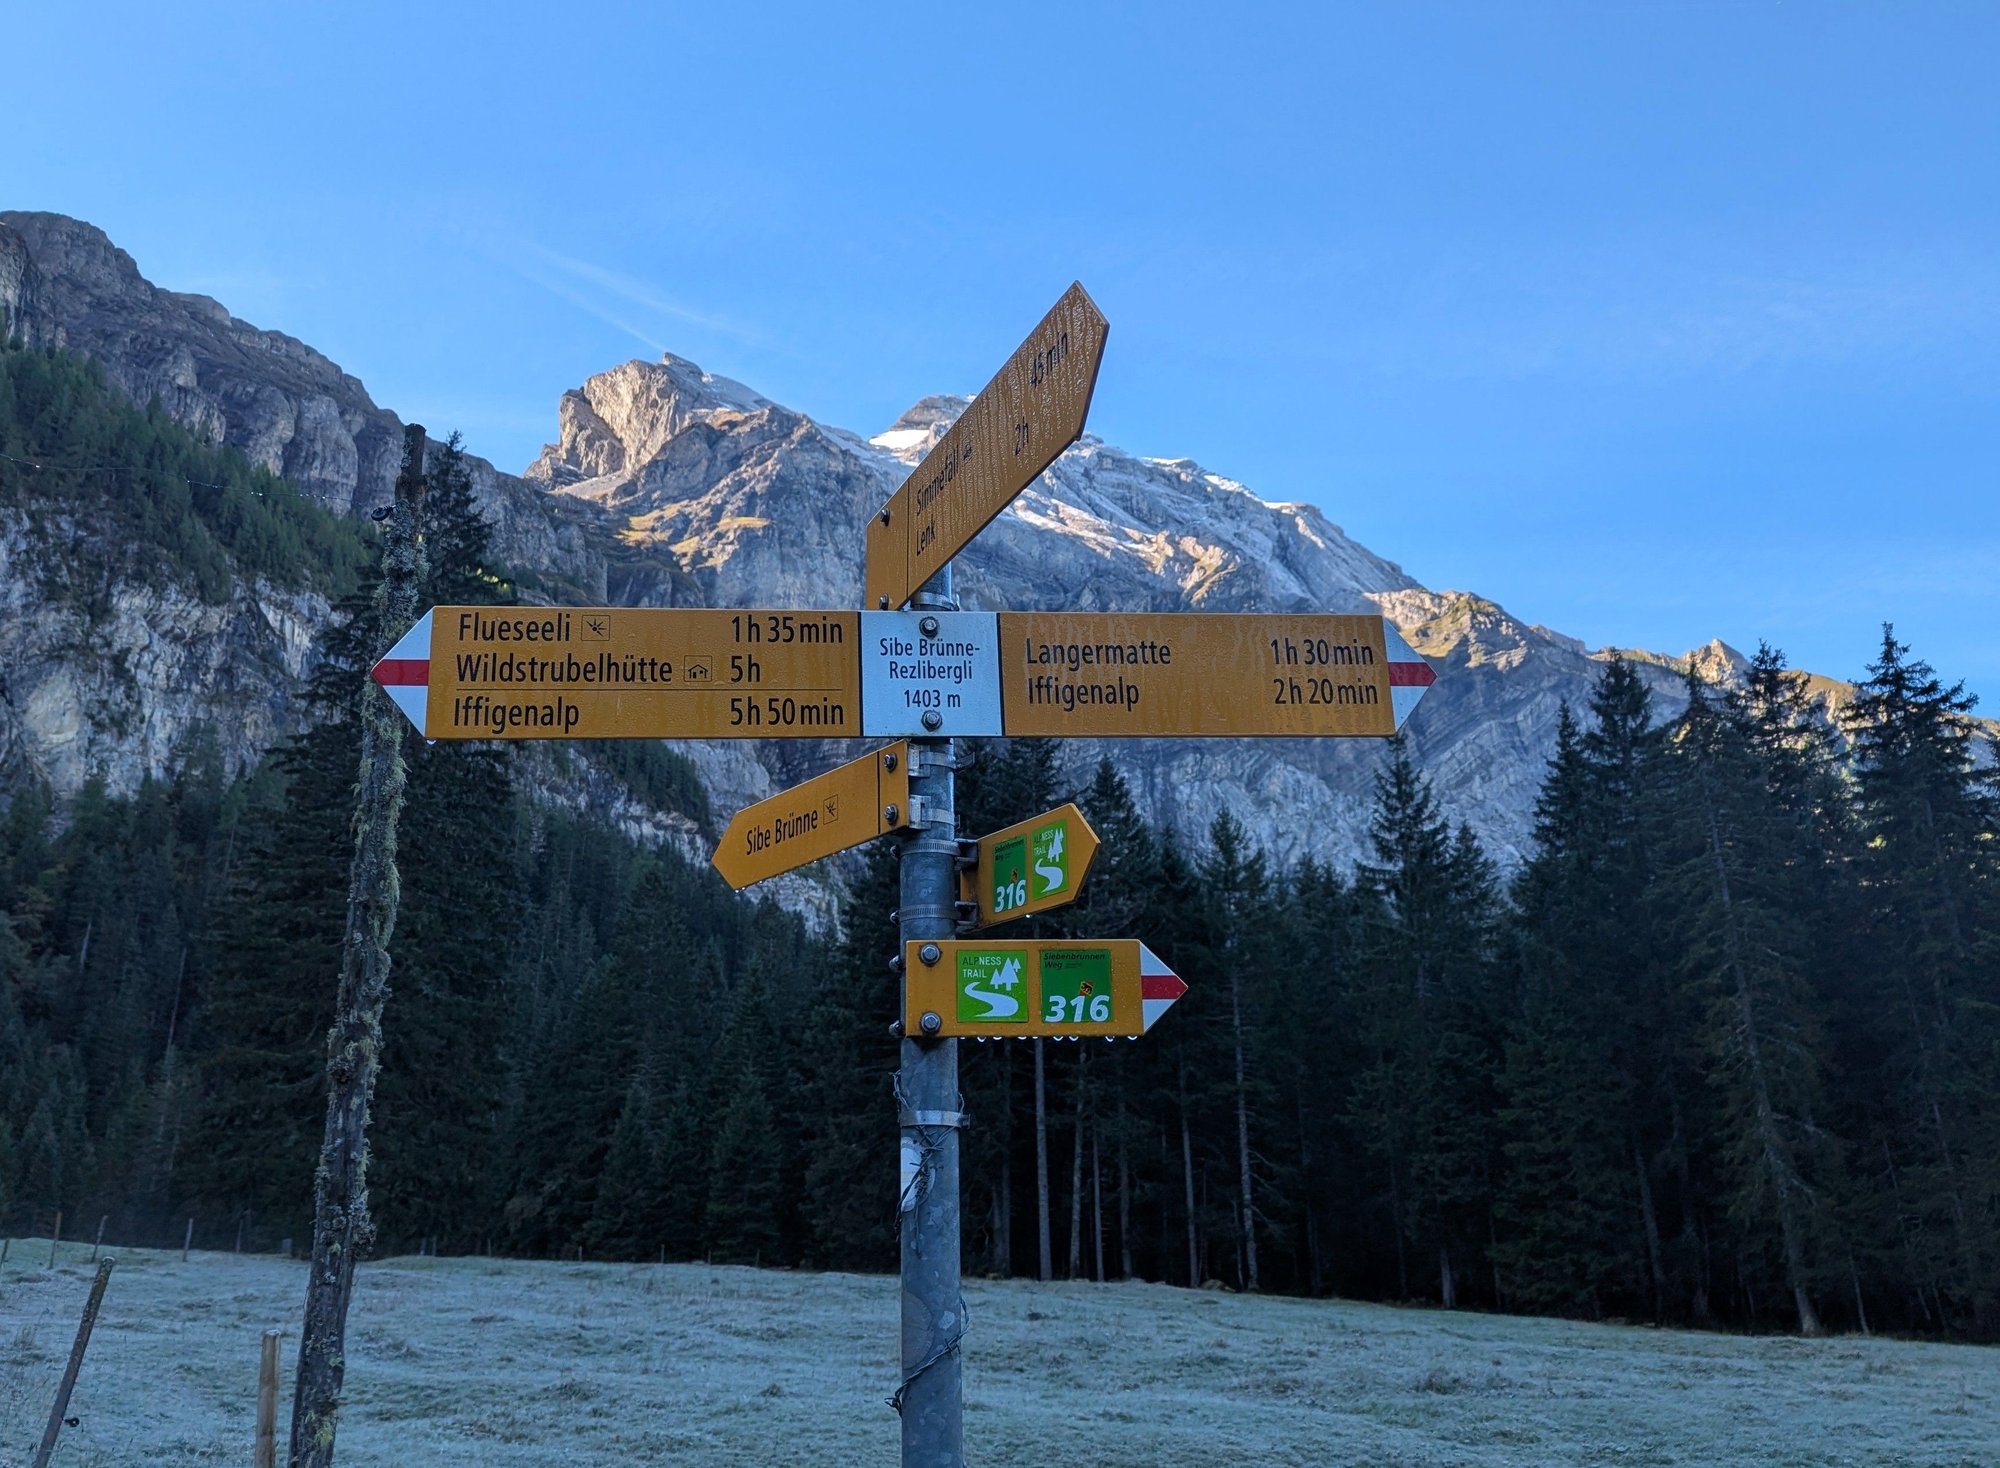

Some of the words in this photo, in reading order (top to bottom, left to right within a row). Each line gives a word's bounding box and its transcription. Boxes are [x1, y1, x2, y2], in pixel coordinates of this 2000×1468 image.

[916, 514, 936, 556] Lenk
[459, 611, 571, 641] Flueseeli
[879, 637, 913, 656] Sibe
[919, 638, 980, 656] Brünne-
[1025, 637, 1171, 672] Langermatte
[456, 652, 673, 683] Wildstrubelhütte
[889, 660, 973, 684] Rezlibergli
[904, 689, 941, 708] 1403
[947, 693, 961, 708] m
[1028, 676, 1140, 712] Iffigenalp
[453, 696, 580, 734] Iffigenalp
[746, 826, 771, 856] Sibe
[775, 809, 818, 845] Brünne
[995, 880, 1026, 912] 316
[962, 956, 1002, 966] ALPNESS
[963, 969, 987, 979] TRAIL
[1045, 995, 1110, 1022] 316
